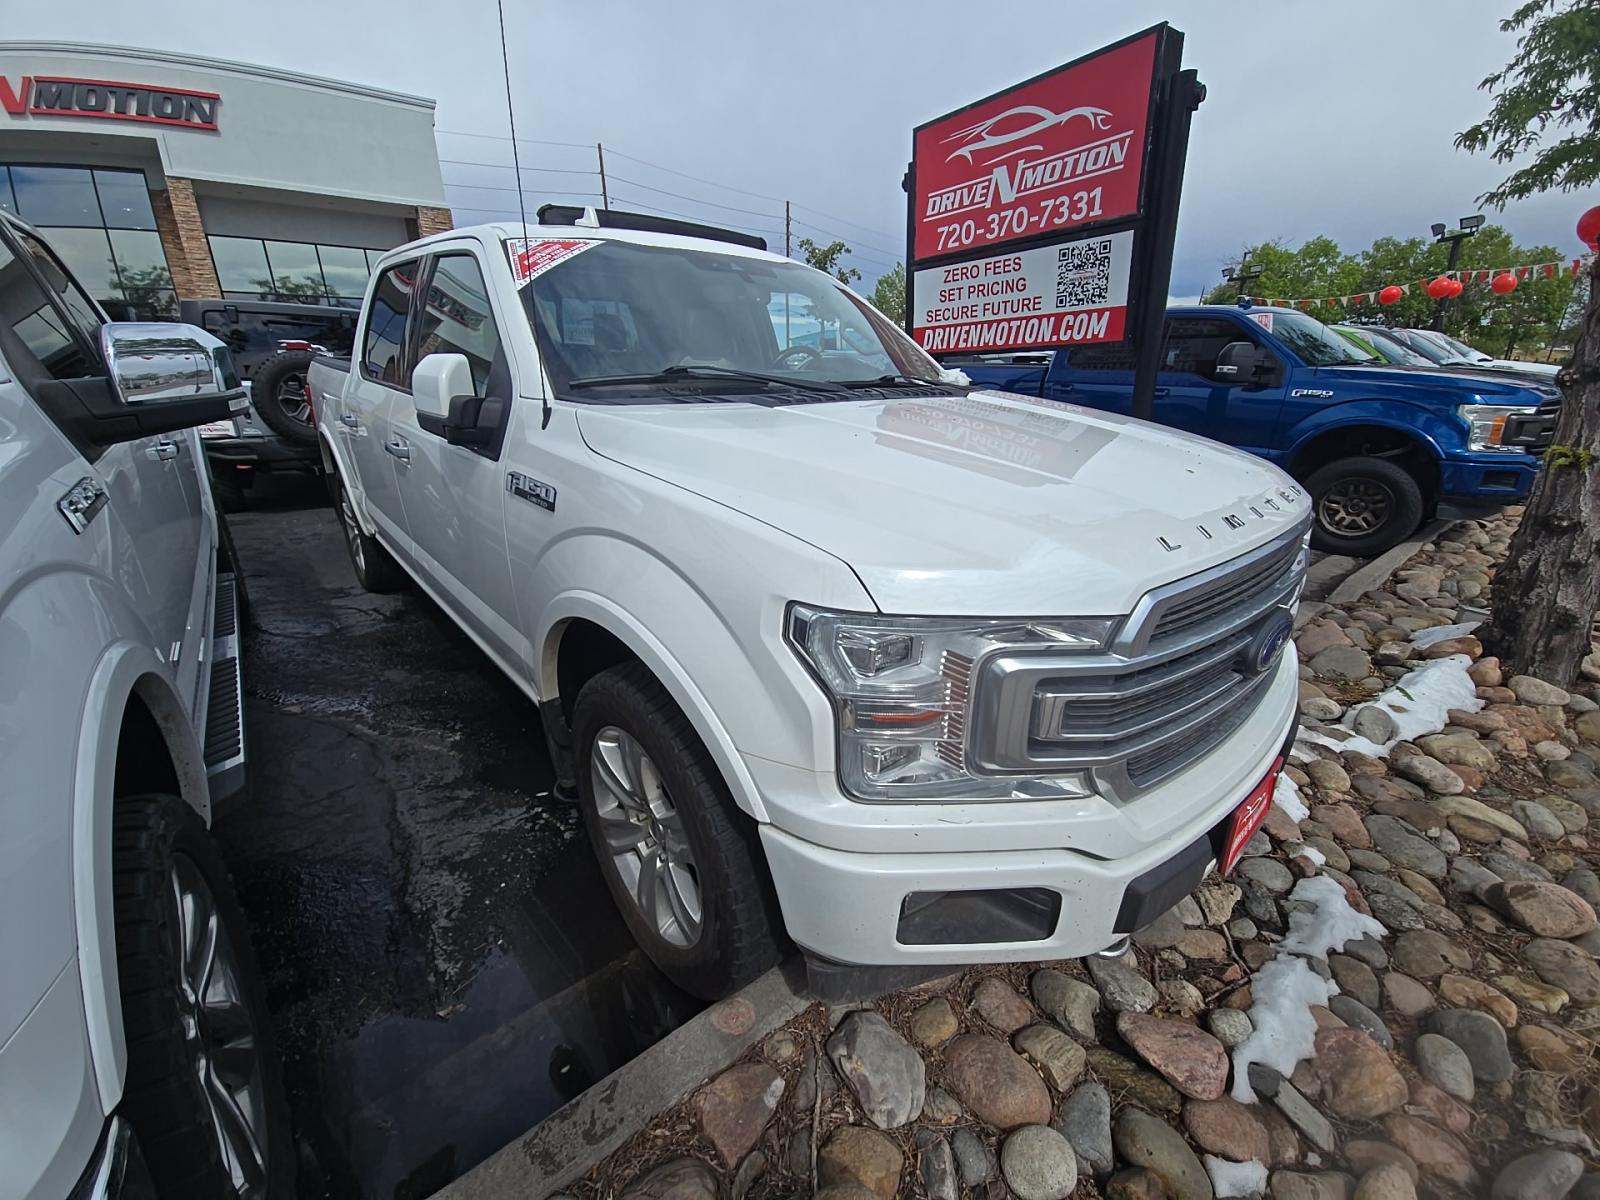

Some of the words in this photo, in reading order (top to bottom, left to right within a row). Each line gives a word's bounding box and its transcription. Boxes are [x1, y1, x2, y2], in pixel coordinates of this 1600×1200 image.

[937, 186, 1103, 251] 720-370-7331
[943, 264, 980, 284] ZERO
[984, 256, 1022, 278] FEES
[939, 287, 963, 303] SET
[968, 277, 1027, 299] PRICING
[926, 301, 978, 323] SECURE
[982, 296, 1042, 318] FUTURE
[923, 311, 1110, 351] DRIVENMOTION.COM
[1156, 485, 1302, 552] LIMITED
